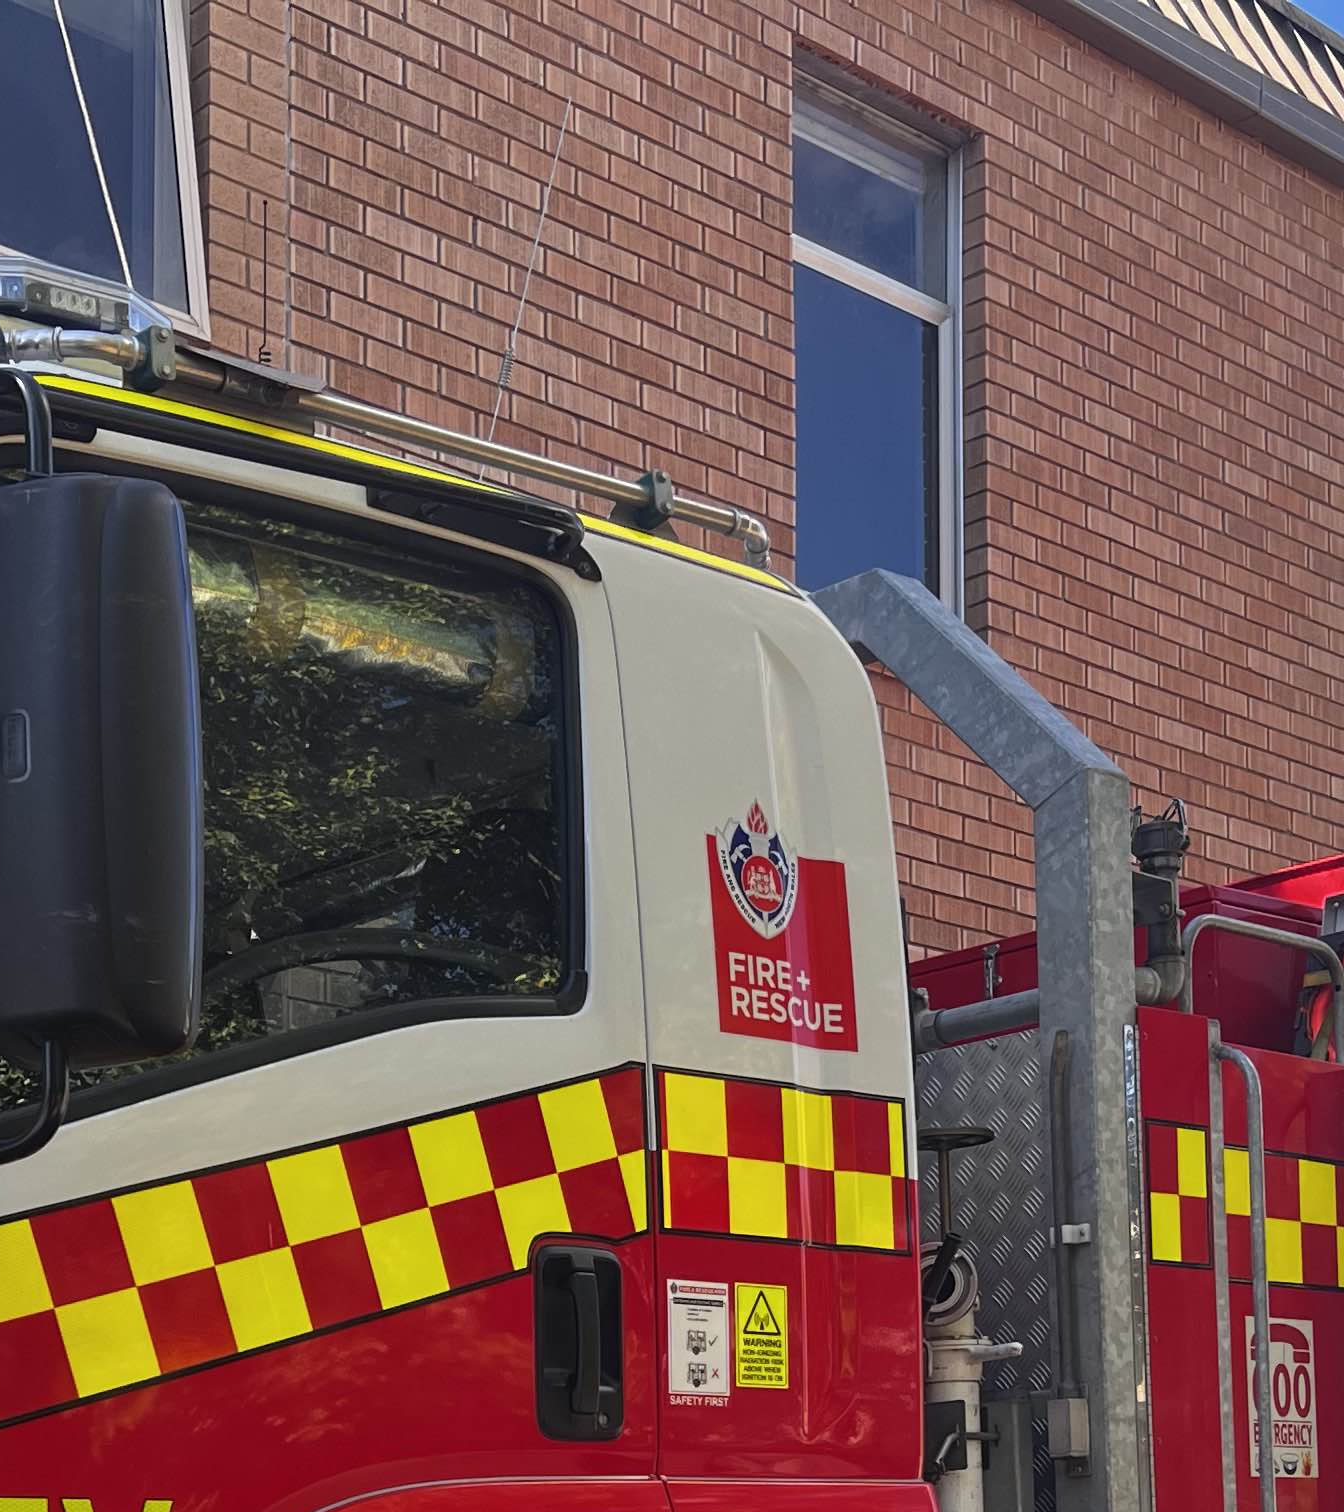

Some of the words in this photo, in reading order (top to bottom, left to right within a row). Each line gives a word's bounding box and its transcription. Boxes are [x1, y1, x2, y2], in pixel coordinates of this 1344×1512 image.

[720, 849, 729, 873] FIRE
[725, 873, 736, 894] AND
[734, 893, 757, 925] RESCUE
[730, 986, 844, 1033] RESCUE
[743, 1337, 782, 1349] WARNING
[669, 1395, 703, 1406] SAFETY
[704, 1396, 729, 1407] FIRST
[1253, 1362, 1312, 1418] 00
[1254, 1423, 1312, 1446] ERGENCY
